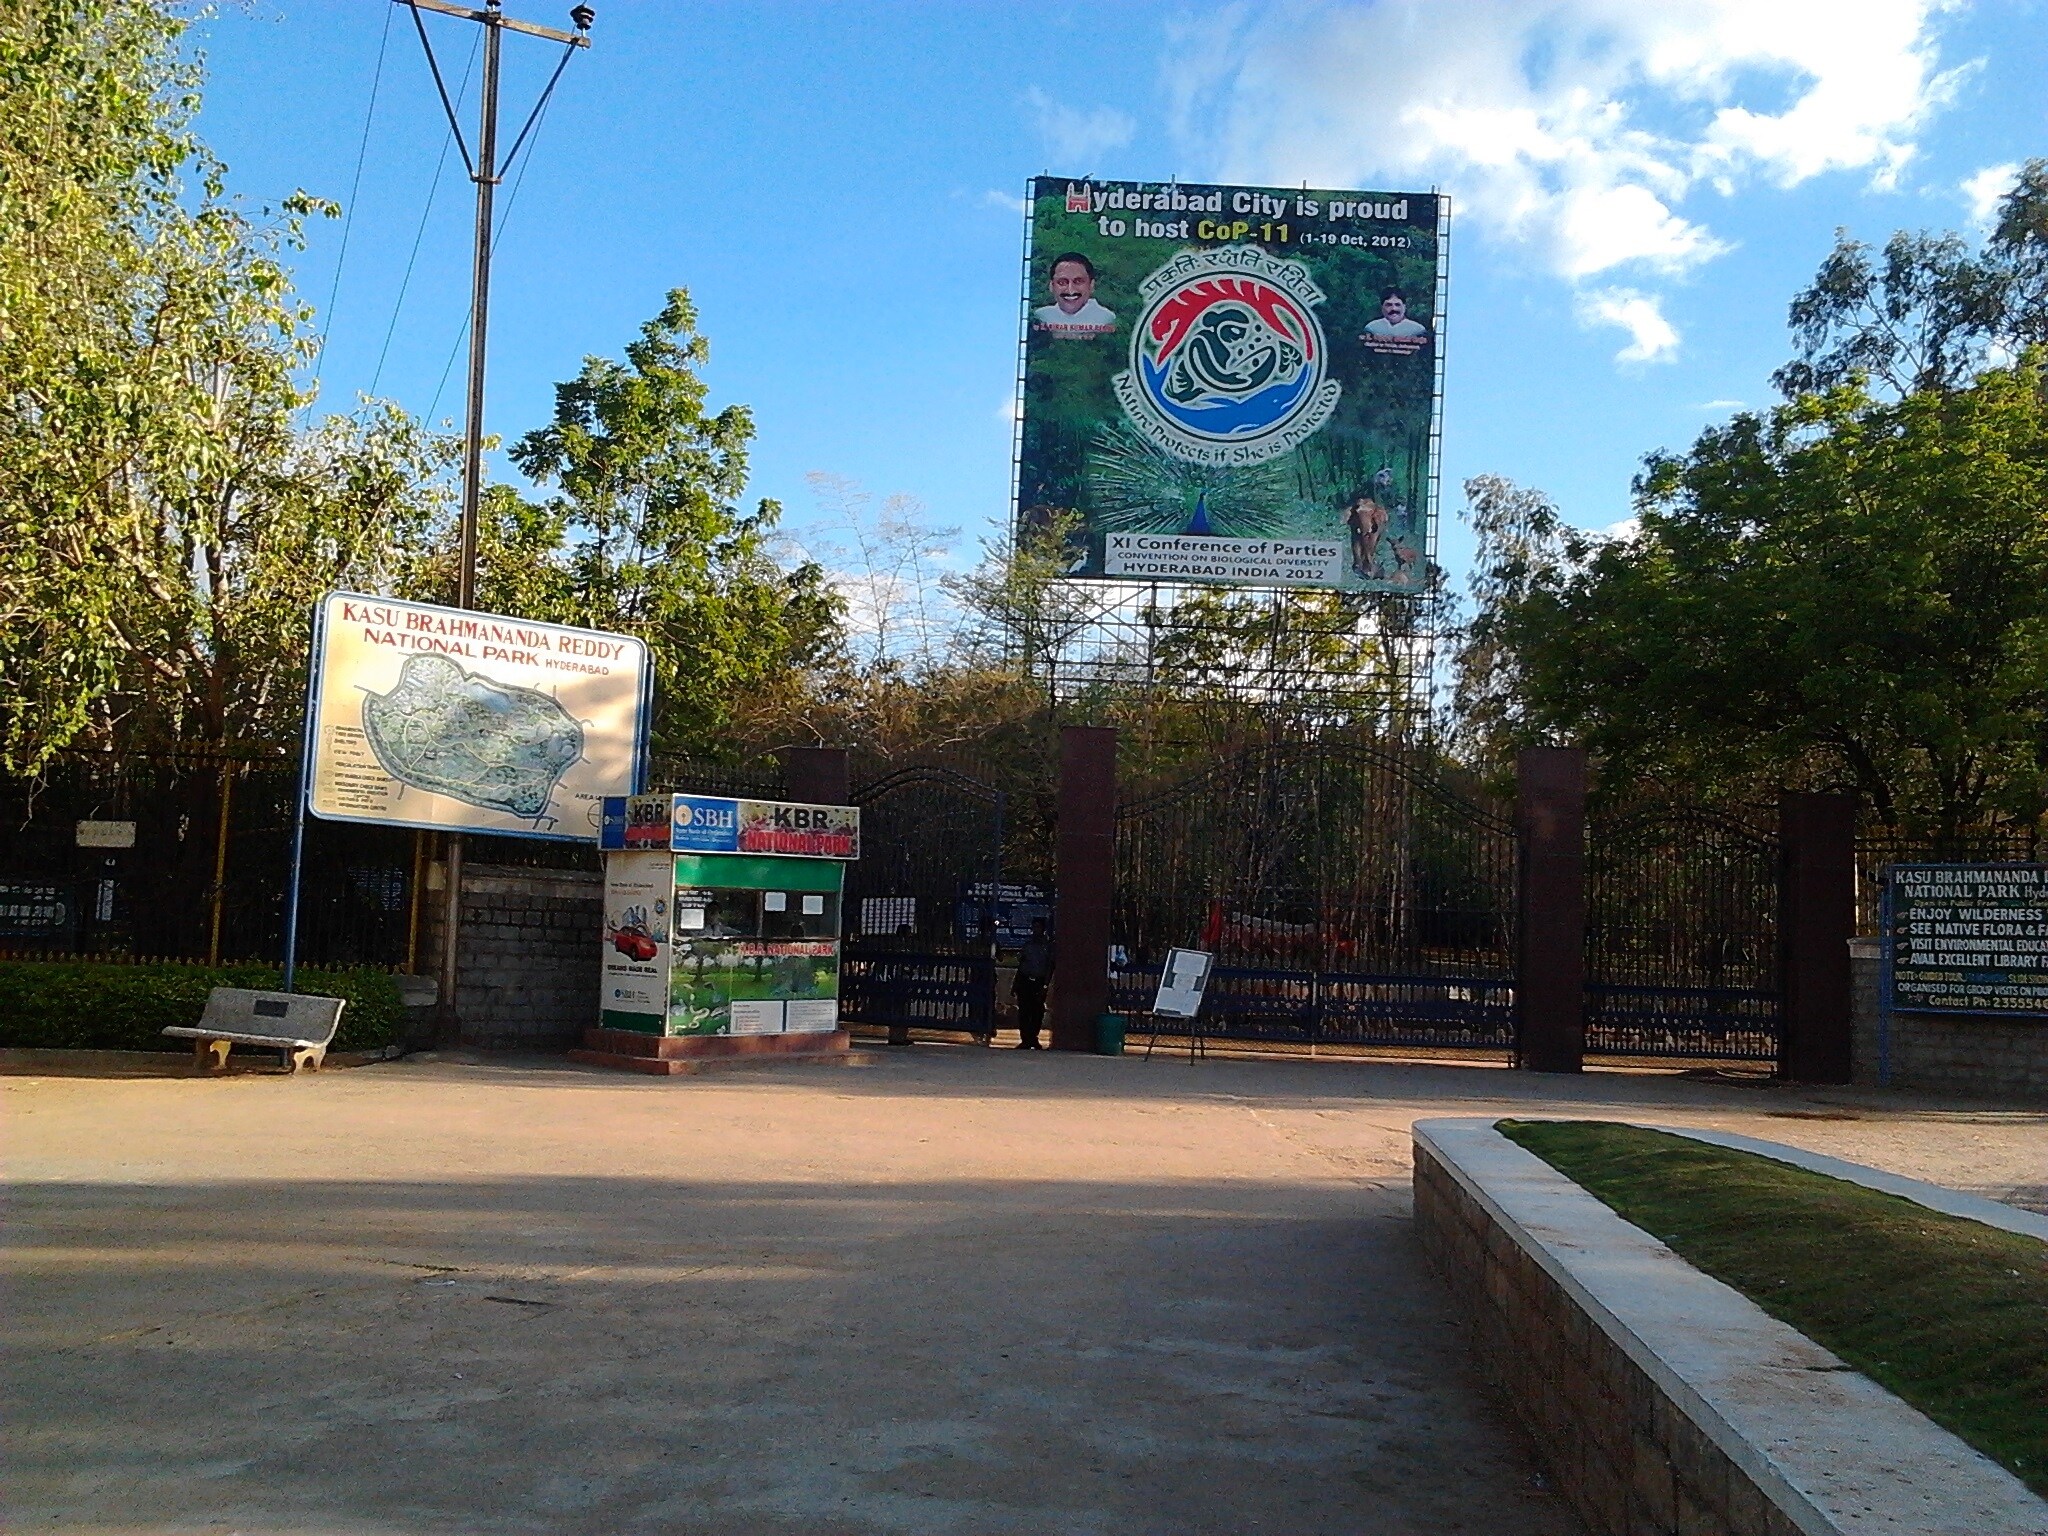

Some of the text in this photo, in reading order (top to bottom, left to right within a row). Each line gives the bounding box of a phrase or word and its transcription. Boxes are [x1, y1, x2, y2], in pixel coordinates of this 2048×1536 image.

[1232, 192, 1287, 219] City
[1297, 196, 1319, 216] is
[1329, 199, 1408, 221] proud
[1099, 215, 1125, 237] to
[1135, 218, 1189, 239] host
[1198, 220, 1289, 242] CoP-11
[1300, 232, 1336, 246] (1-19
[1371, 235, 1411, 248] 2012)
[1117, 374, 1337, 463] Nature Protects if She is Protected
[1112, 536, 1337, 557] XI Conference of Parties
[1117, 551, 1329, 567] CONVENTION ON BIOLOGICAL DIVERSITY
[1123, 562, 1324, 579] HYDERABAD INDIA 2012
[343, 602, 625, 661] KASU BRAHMANANDA REDDY
[364, 628, 609, 676] NATIONAL PARK HYDERABAD
[634, 803, 665, 822] KBR
[693, 807, 734, 828] SBH
[774, 807, 830, 829] KBR
[746, 829, 852, 854] NATIONAL PARK
[1895, 870, 1932, 884] KASU
[1935, 870, 2039, 884] BRAHMANANDA
[1904, 884, 1973, 898] NATIONAL
[1977, 884, 2020, 898] PARK
[1909, 908, 2043, 921] ENJOY WILDERNESS
[1909, 922, 1932, 935] SEE
[1935, 923, 1980, 935] NATIVE
[1982, 923, 2023, 936] FLORA
[2025, 925, 2036, 936] &
[767, 943, 810, 956] NATIONAL
[812, 944, 833, 956] PARK
[1910, 937, 1932, 950] VISIT
[1934, 938, 2014, 951] ENVIRONMENTAL
[1909, 952, 1938, 965] AVAIL
[1938, 953, 1991, 967] EXCELLENT
[1994, 954, 2038, 968] LIBRARY
[1897, 983, 1947, 993] ORGANISED
[1949, 984, 1966, 994] FOR
[1966, 984, 1993, 994] GROUP
[1994, 985, 2019, 995] VISITS
[1928, 995, 1969, 1006] Contact
